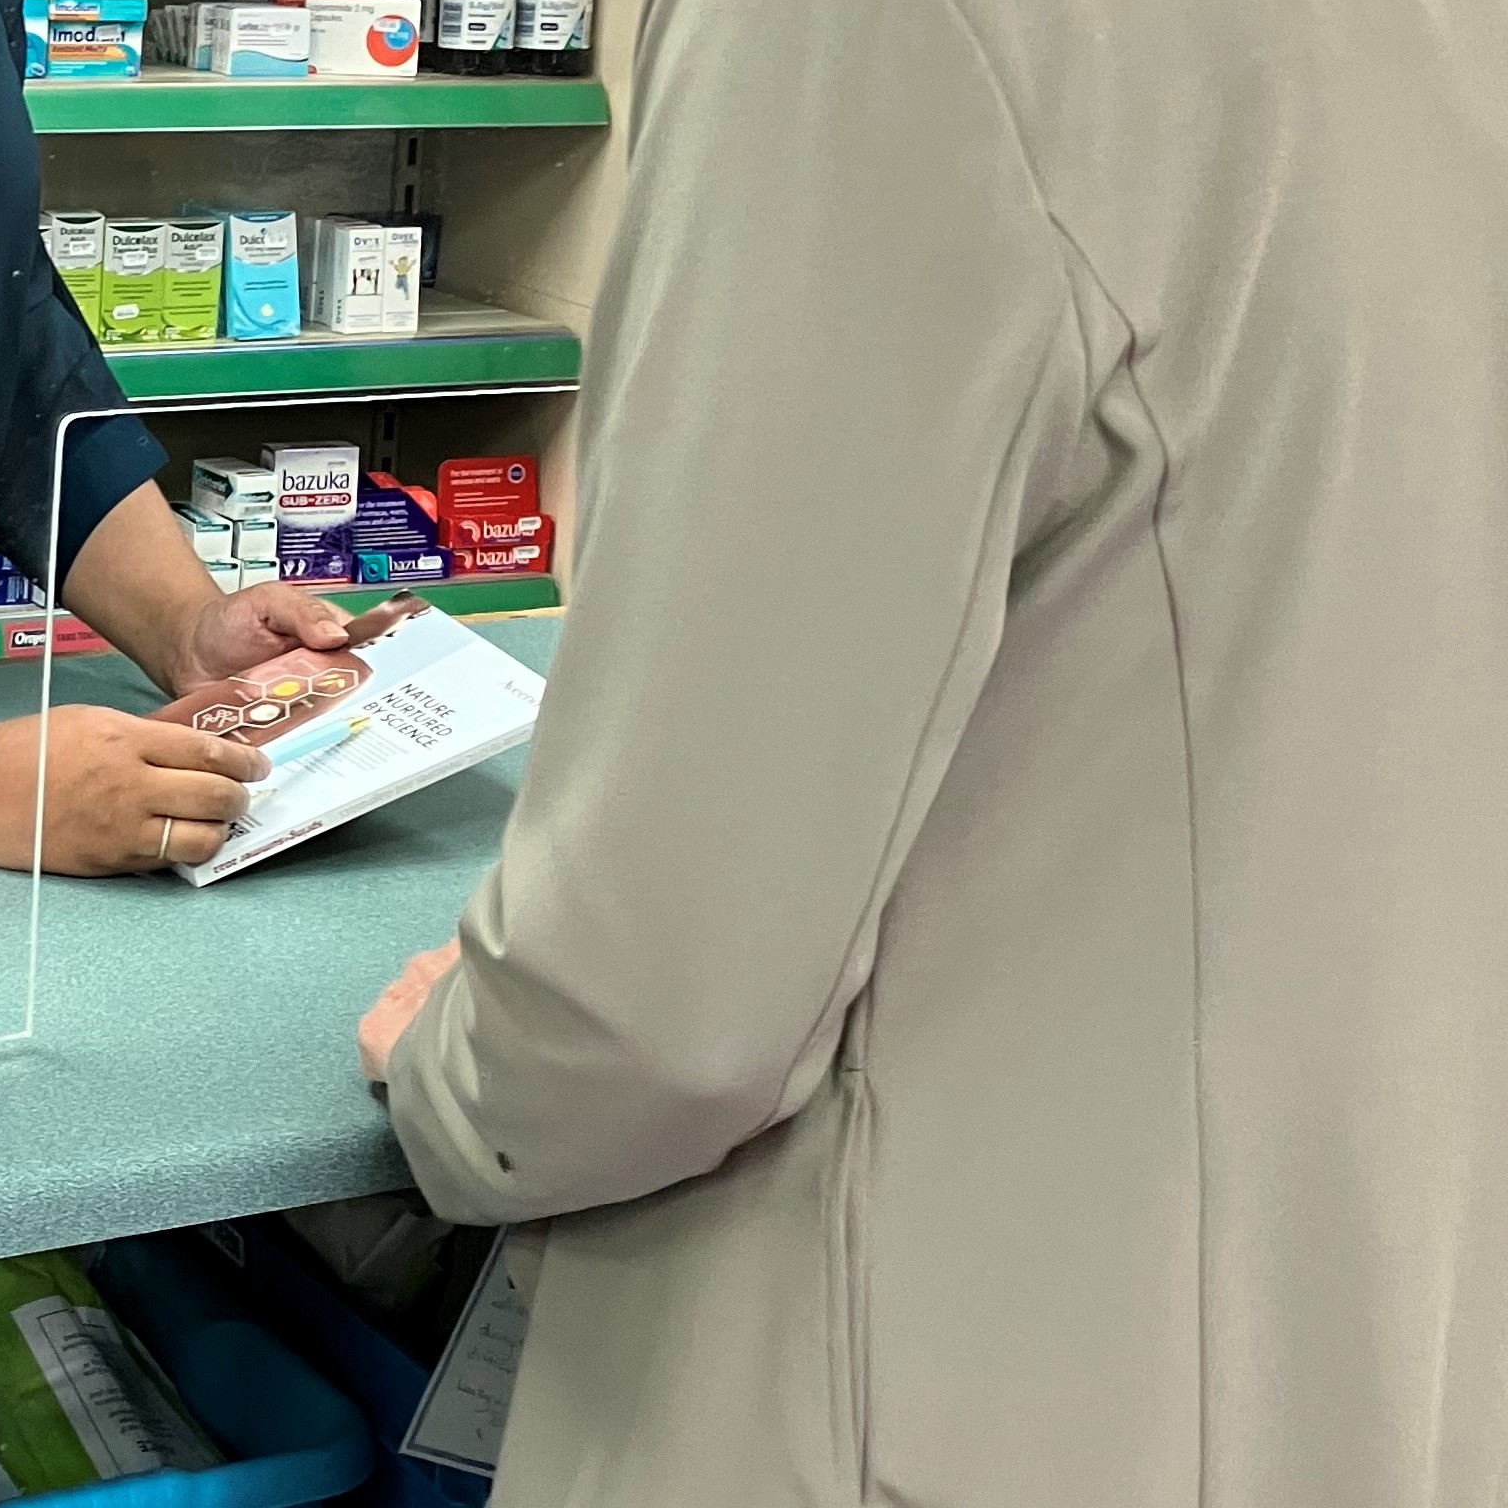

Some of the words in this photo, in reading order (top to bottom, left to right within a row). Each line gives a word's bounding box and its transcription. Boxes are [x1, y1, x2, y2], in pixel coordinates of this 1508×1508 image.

[112, 235, 158, 246] Dulcolax
[171, 233, 216, 243] Dulcolax
[282, 469, 349, 492] bazuka
[282, 494, 350, 506] SUB-ZERO
[381, 693, 453, 736] NURTURED
[363, 702, 387, 716] BY
[380, 713, 439, 749] SCIENCE
